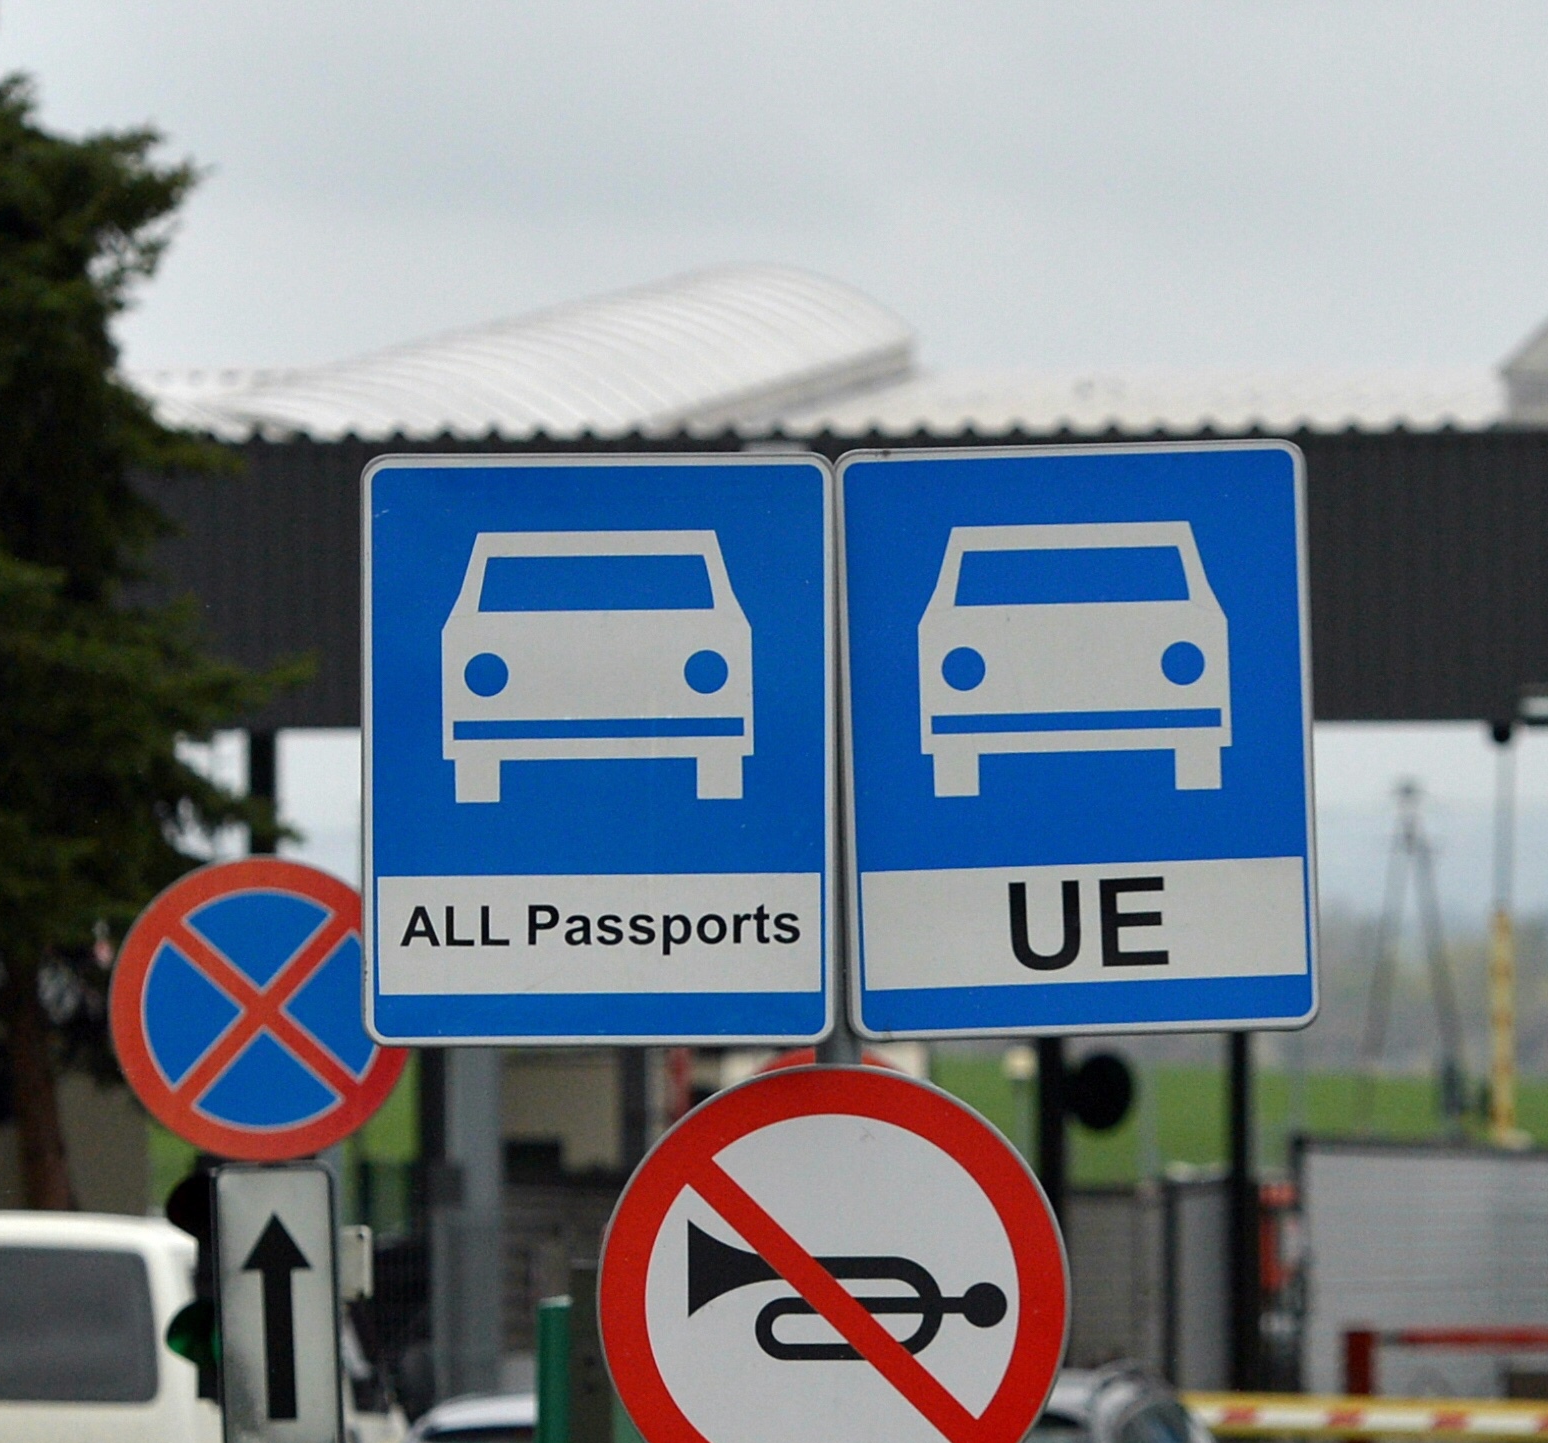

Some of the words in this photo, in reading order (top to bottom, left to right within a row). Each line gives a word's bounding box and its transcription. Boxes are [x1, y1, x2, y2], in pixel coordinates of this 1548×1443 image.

[400, 905, 510, 947] ALL
[527, 903, 801, 955] Passports
[1008, 876, 1169, 971] UE
